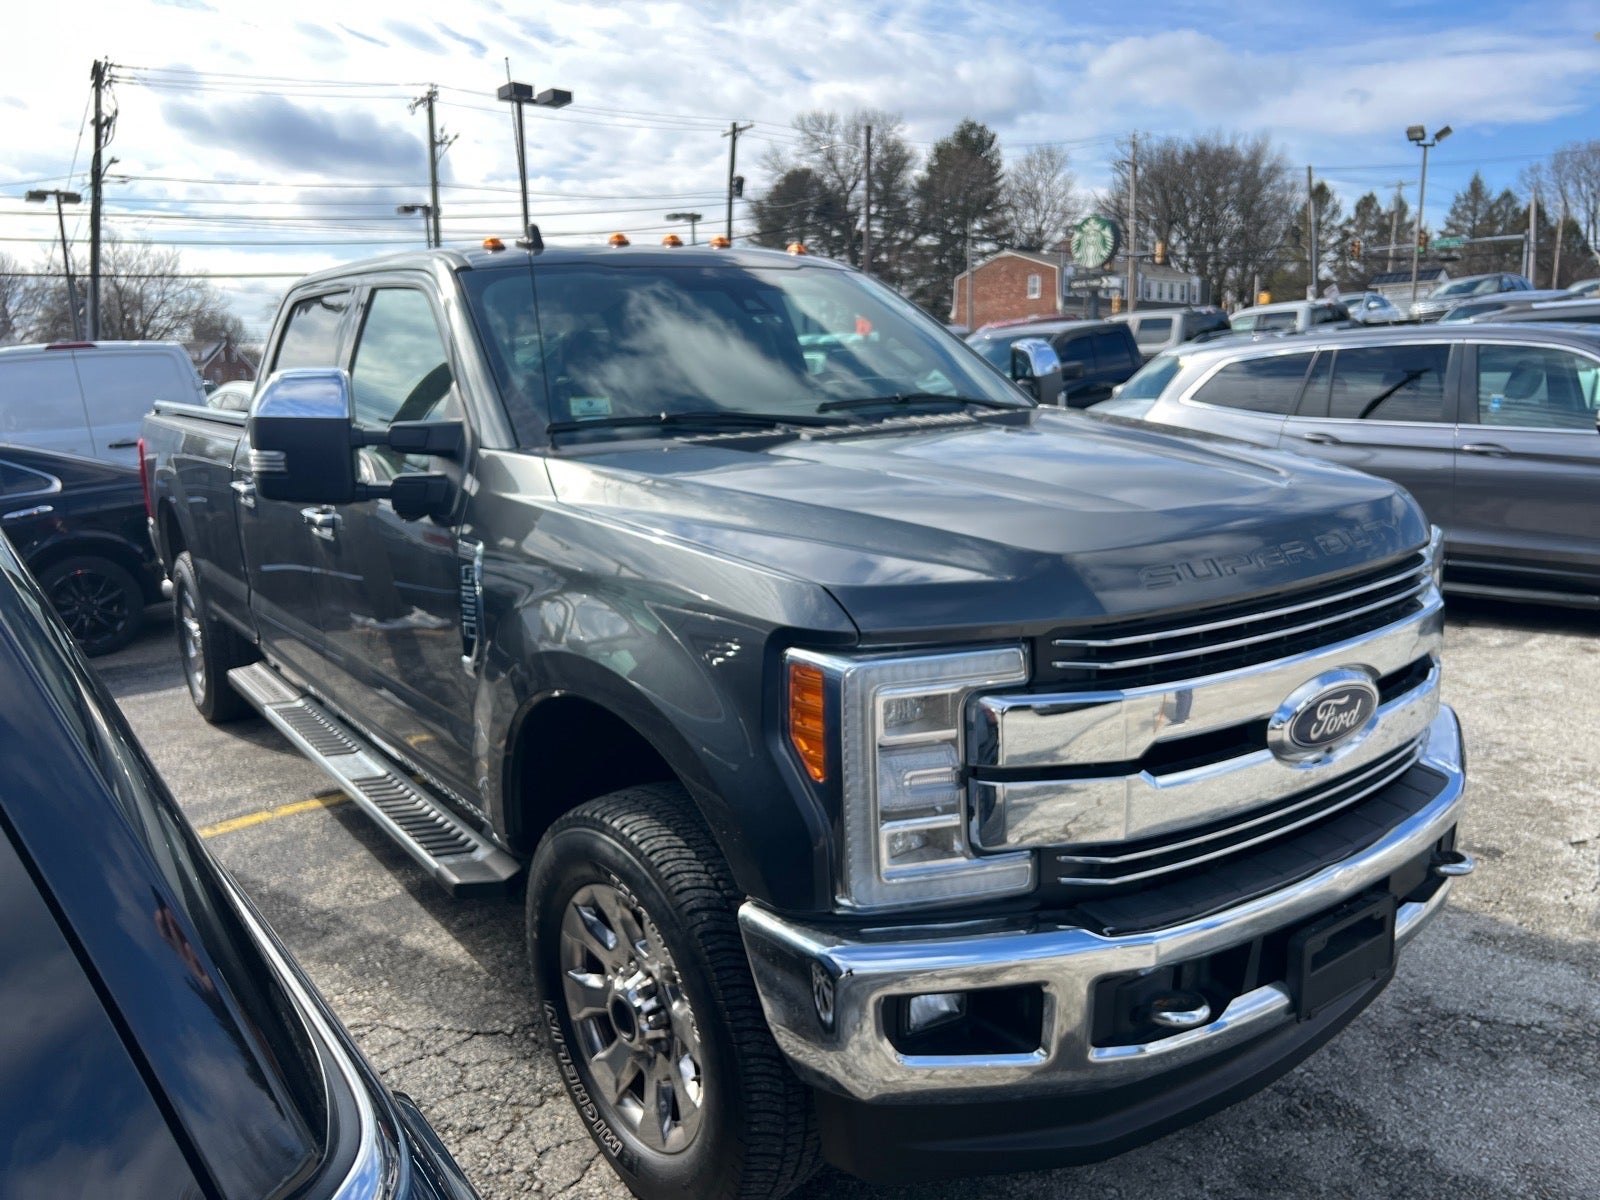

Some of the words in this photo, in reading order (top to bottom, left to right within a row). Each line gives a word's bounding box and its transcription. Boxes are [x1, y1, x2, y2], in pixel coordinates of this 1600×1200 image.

[1138, 540, 1318, 591] SUPER
[1309, 694, 1362, 740] Ford
[543, 1003, 624, 1157] MICHELIN
